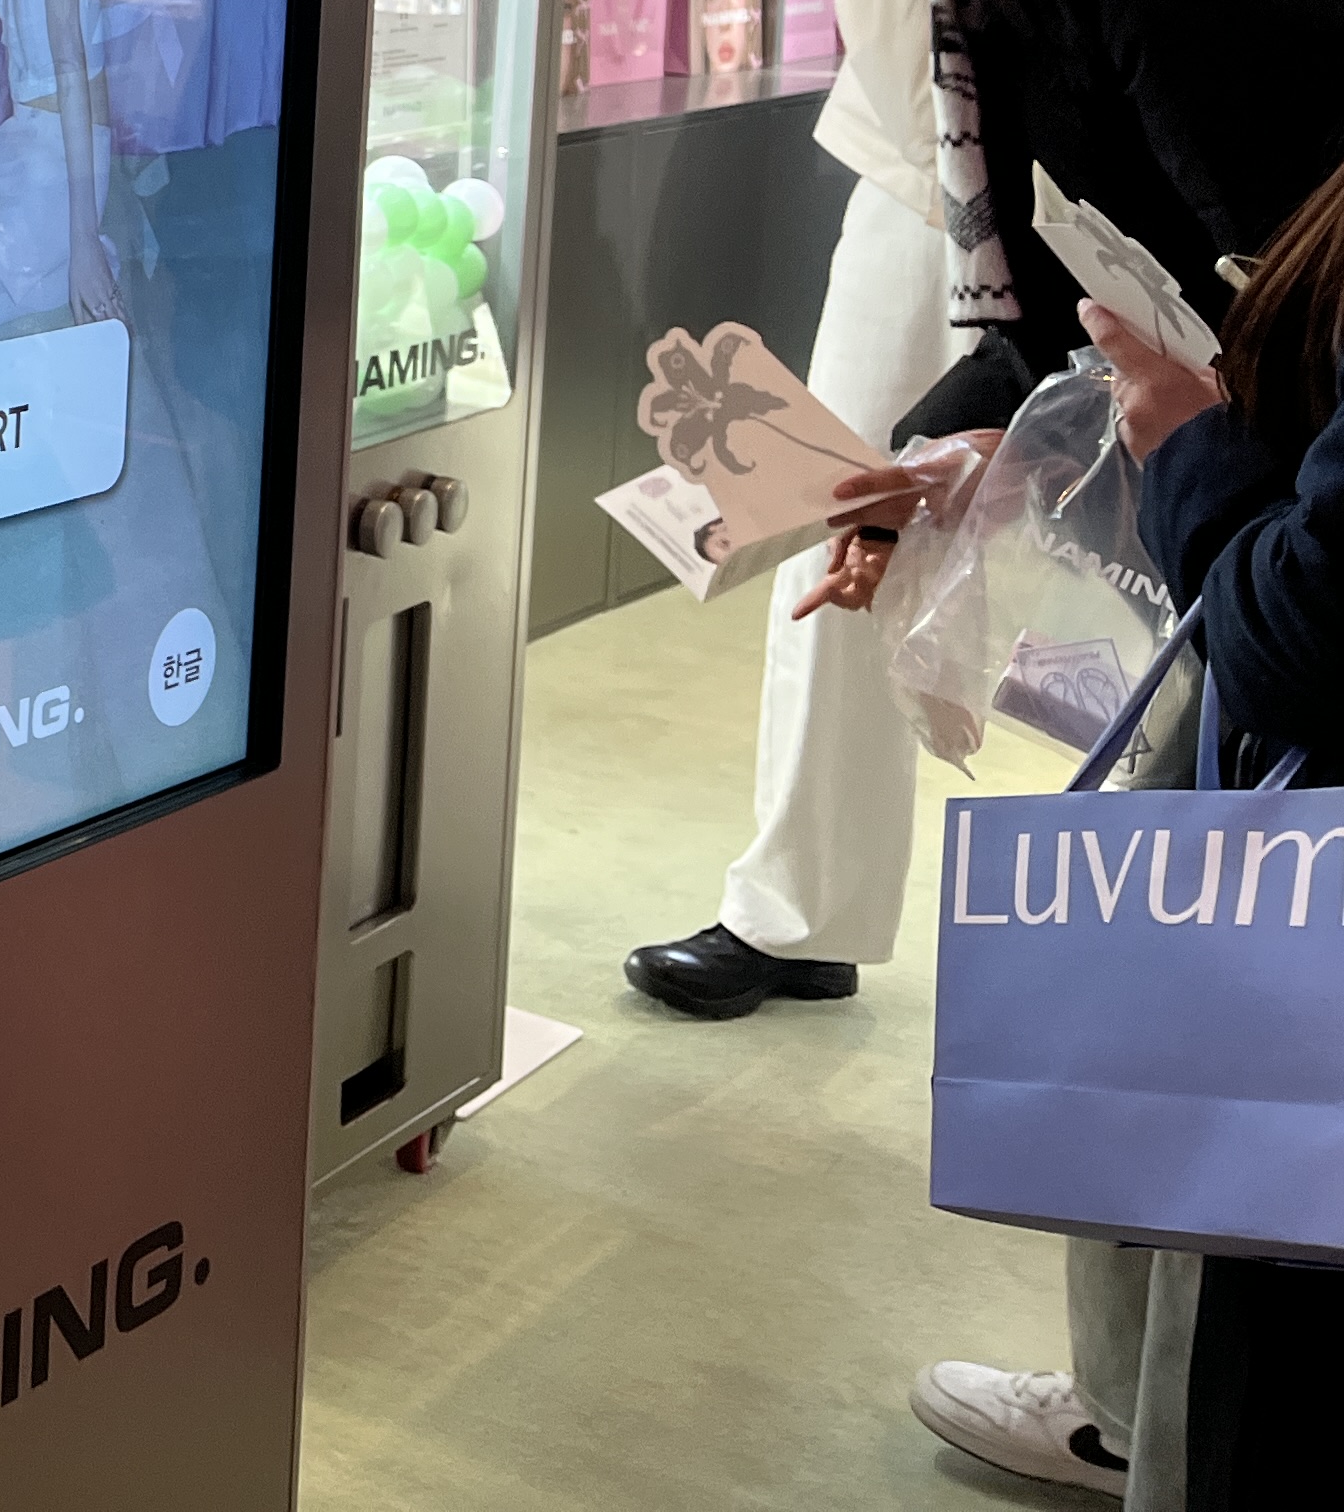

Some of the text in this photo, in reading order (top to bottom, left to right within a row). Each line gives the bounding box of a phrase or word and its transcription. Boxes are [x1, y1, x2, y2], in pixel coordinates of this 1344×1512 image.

[353, 328, 486, 399] AMING.
[1023, 522, 1176, 613] NAMIN
[162, 646, 204, 692] 한글
